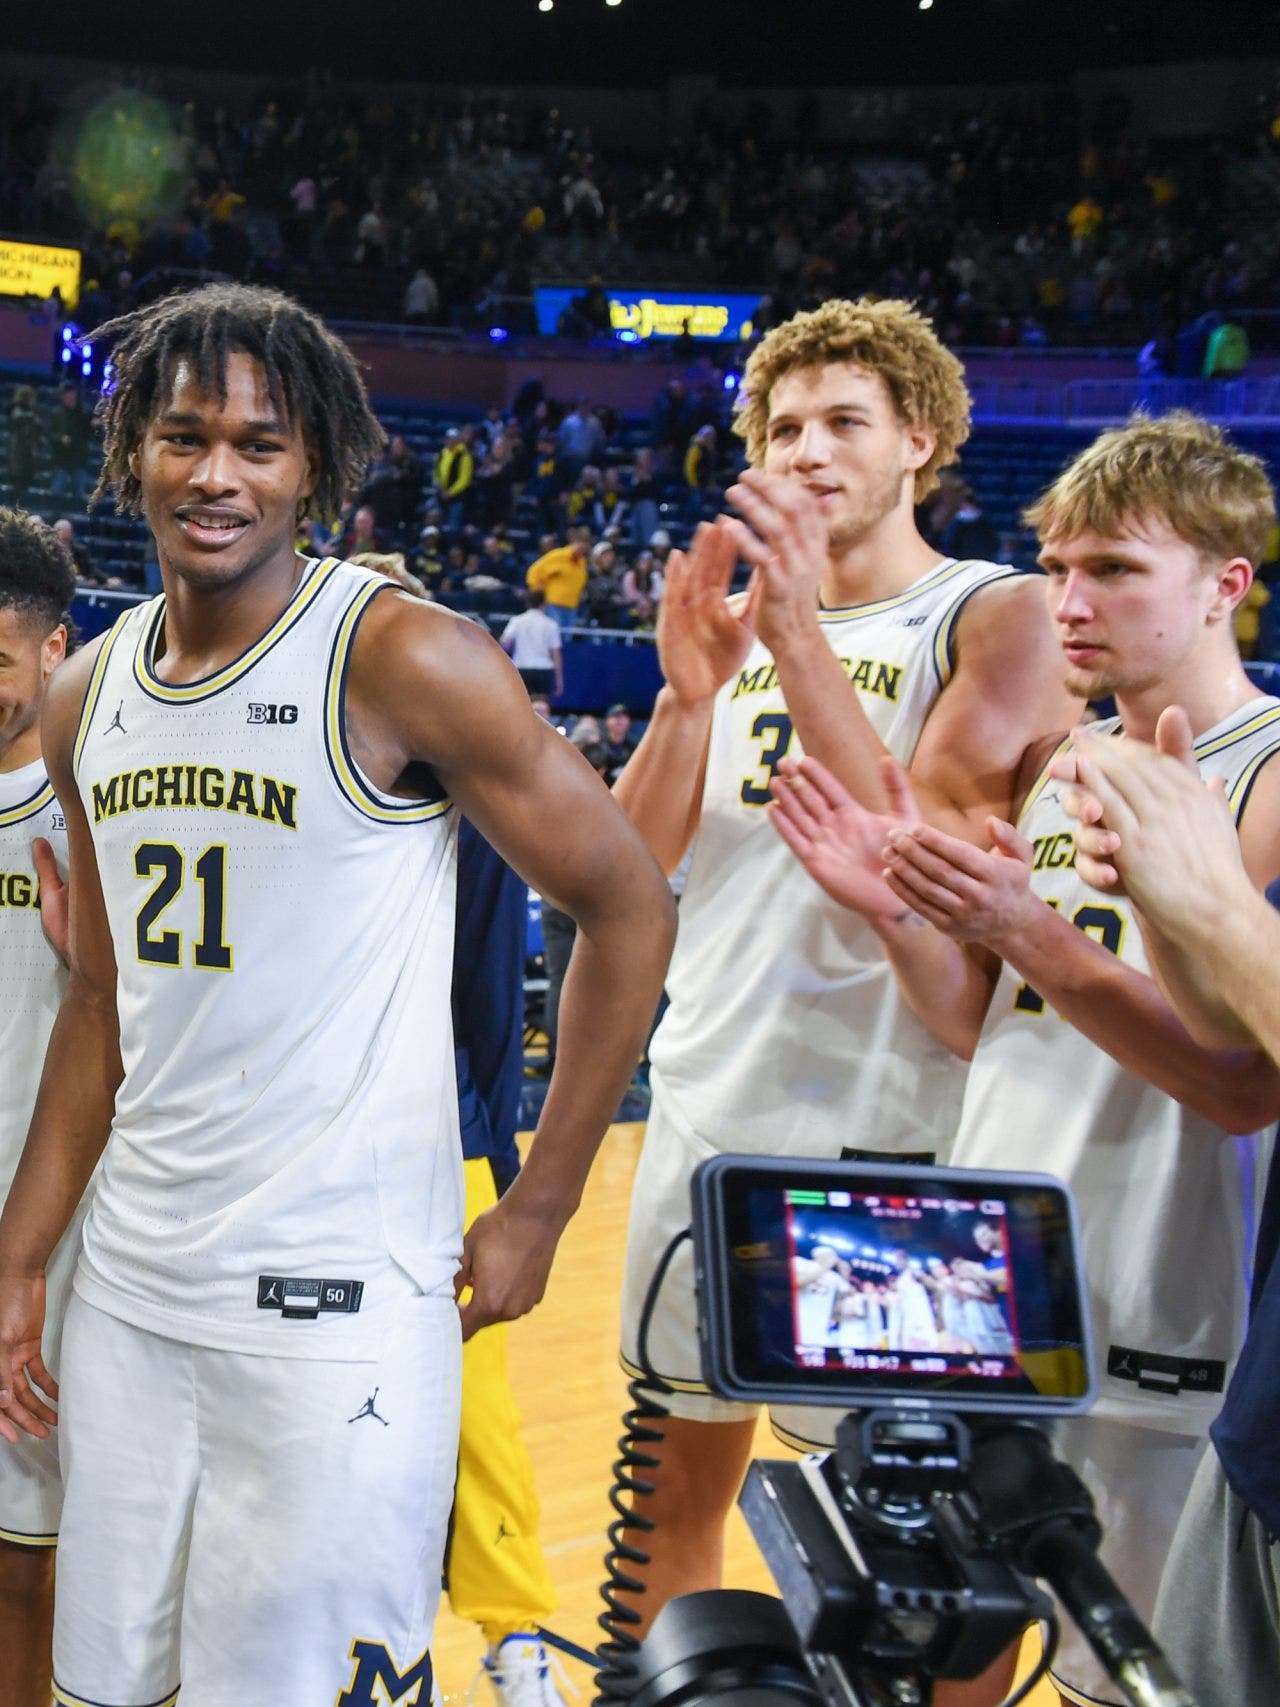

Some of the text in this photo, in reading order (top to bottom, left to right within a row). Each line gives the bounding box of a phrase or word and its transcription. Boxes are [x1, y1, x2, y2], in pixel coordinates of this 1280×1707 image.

[731, 656, 904, 703] MIAN
[740, 709, 796, 808] 3
[91, 763, 298, 831] MICHIGAN
[133, 840, 235, 972] 21
[326, 1288, 345, 1303] 50
